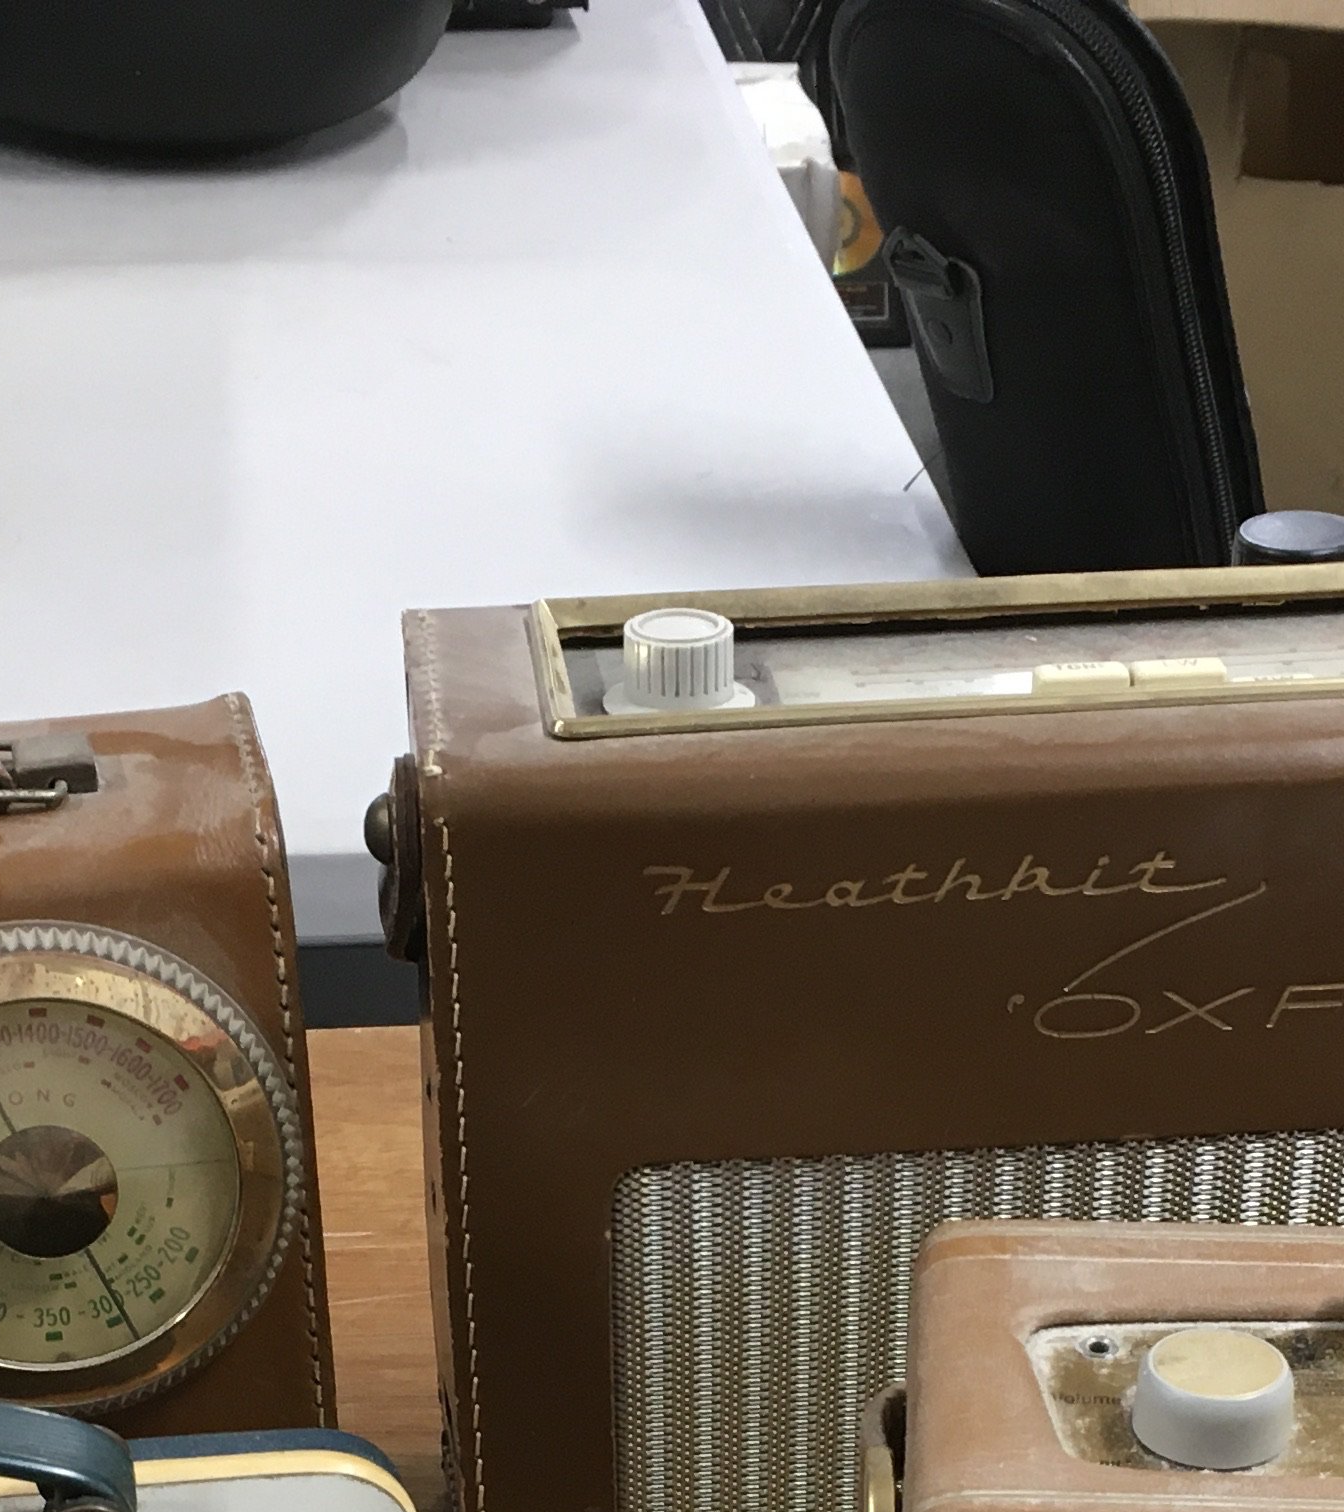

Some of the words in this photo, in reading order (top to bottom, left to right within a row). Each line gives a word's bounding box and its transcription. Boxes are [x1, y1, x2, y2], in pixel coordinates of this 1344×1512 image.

[642, 851, 1228, 915] Heathkit
[33, 1307, 71, 1328] 350
[126, 1264, 162, 1298] 250
[157, 1226, 190, 1264] 200
